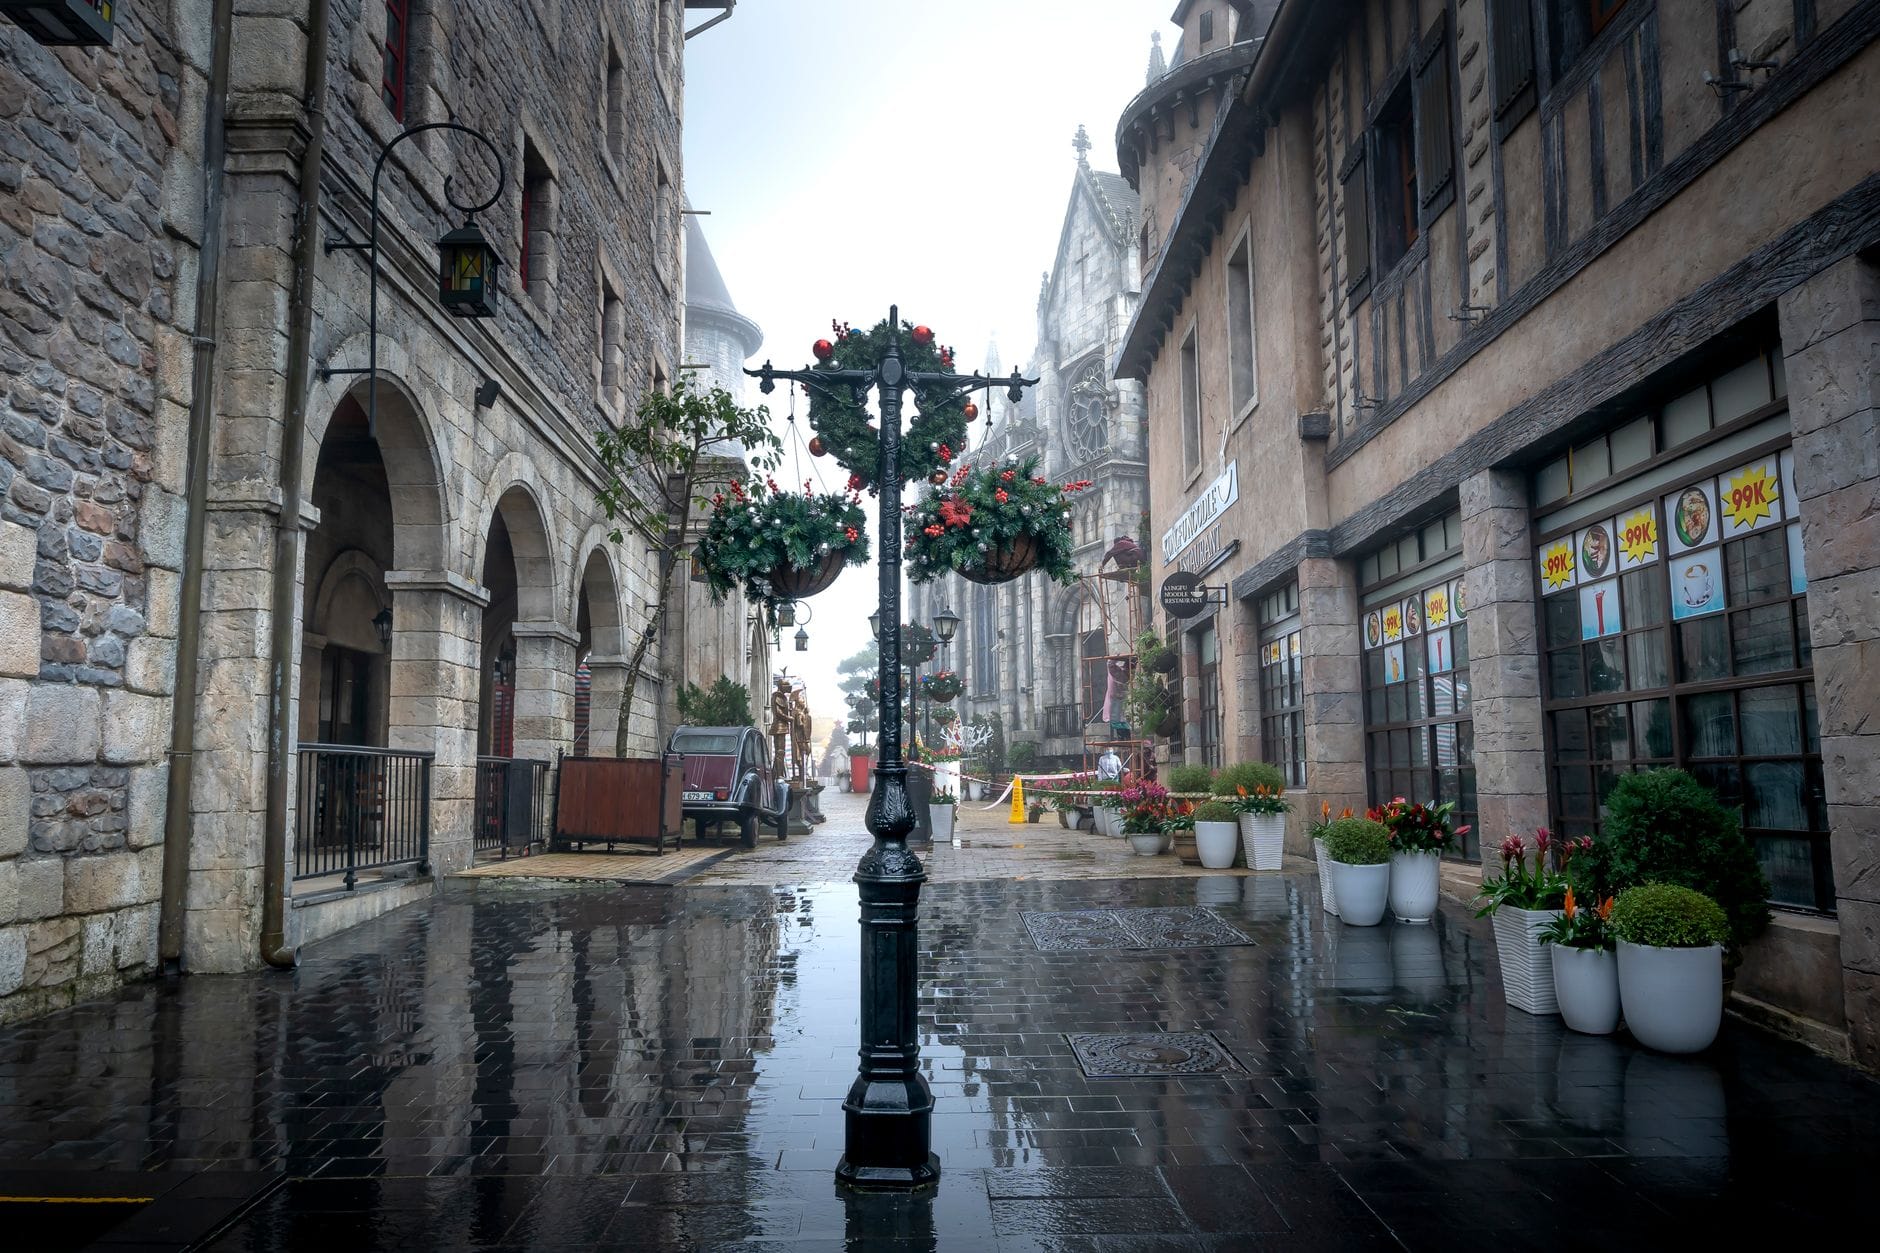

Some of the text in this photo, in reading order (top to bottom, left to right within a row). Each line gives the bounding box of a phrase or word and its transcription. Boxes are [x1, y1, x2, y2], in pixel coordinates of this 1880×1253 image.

[1731, 479, 1766, 513] 99K
[1626, 521, 1651, 548] 99K
[1547, 553, 1567, 577] 99K
[1430, 598, 1444, 616] 99K
[1386, 615, 1398, 631] 99K
